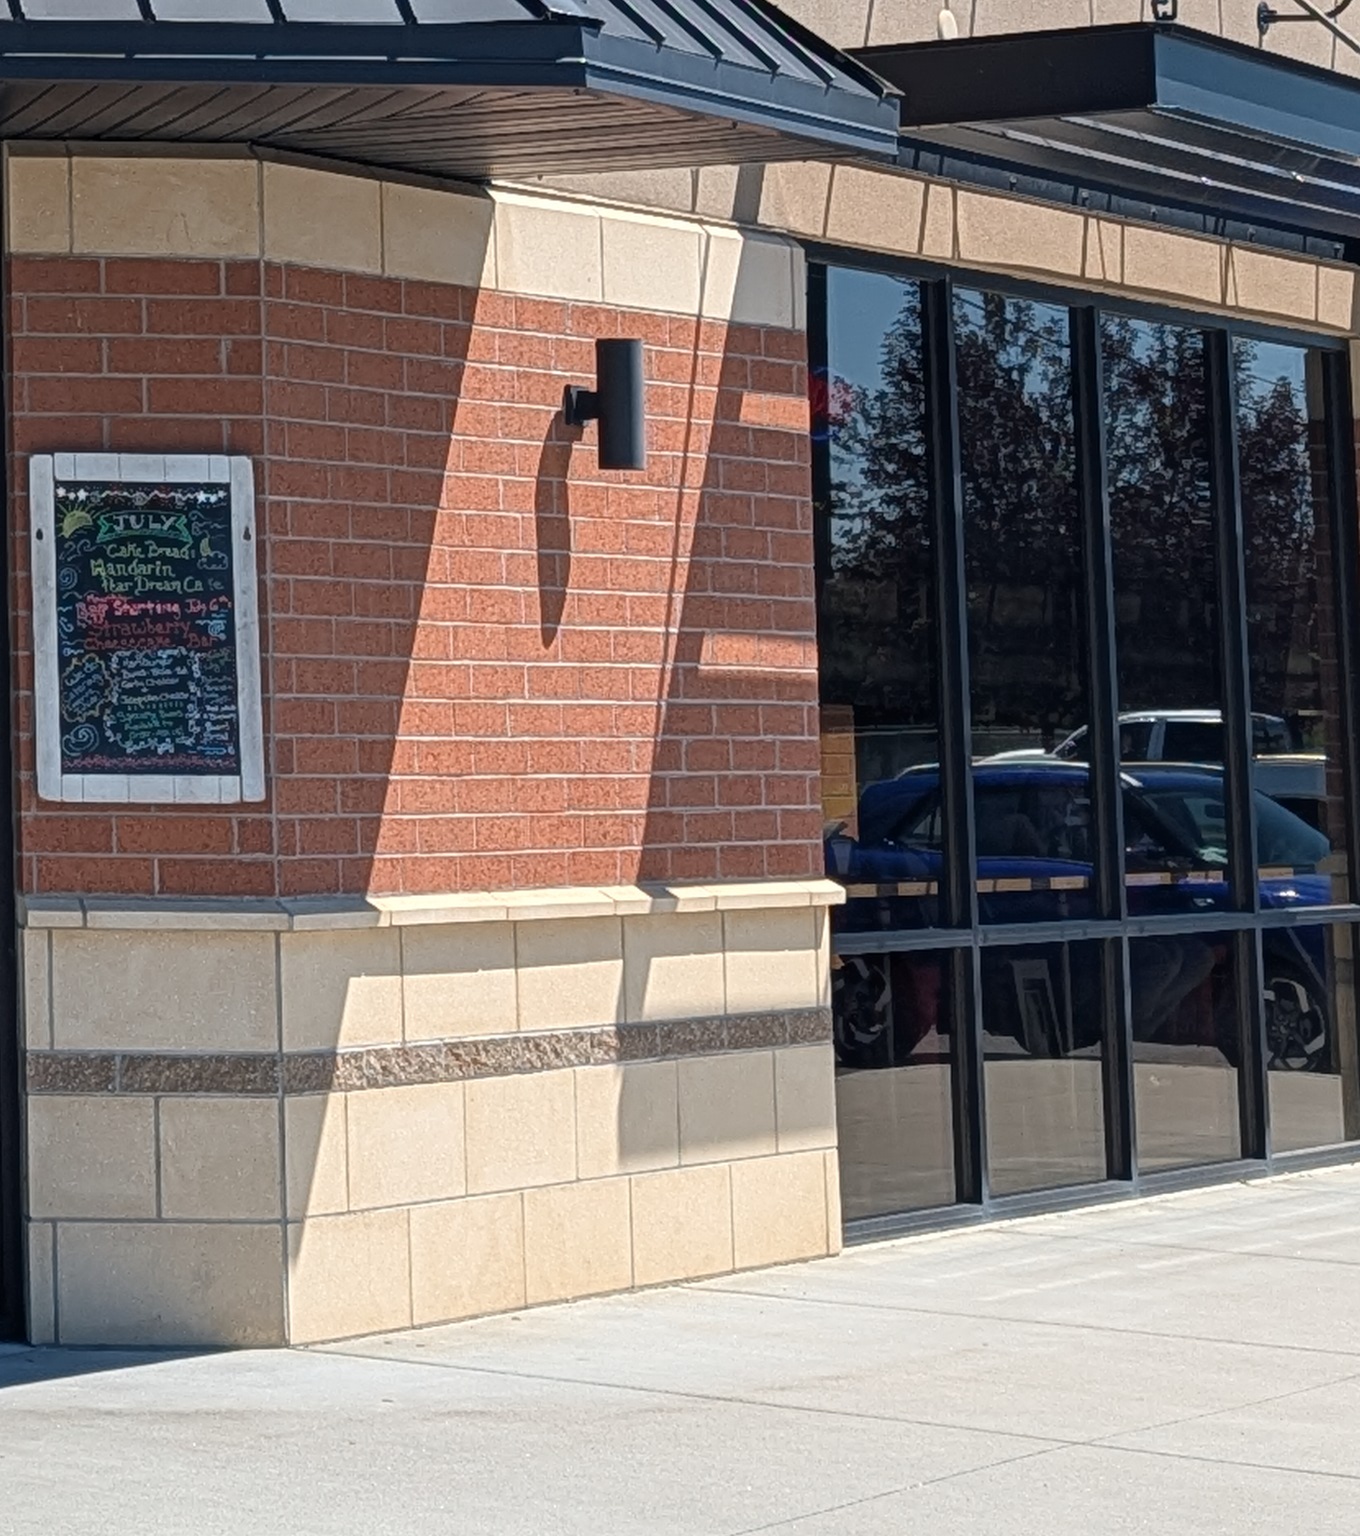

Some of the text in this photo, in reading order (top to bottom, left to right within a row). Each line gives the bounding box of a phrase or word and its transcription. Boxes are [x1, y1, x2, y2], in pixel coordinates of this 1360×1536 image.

[113, 515, 178, 530] JULY
[90, 558, 176, 577] Mandarin
[89, 619, 190, 638] Strawberry
